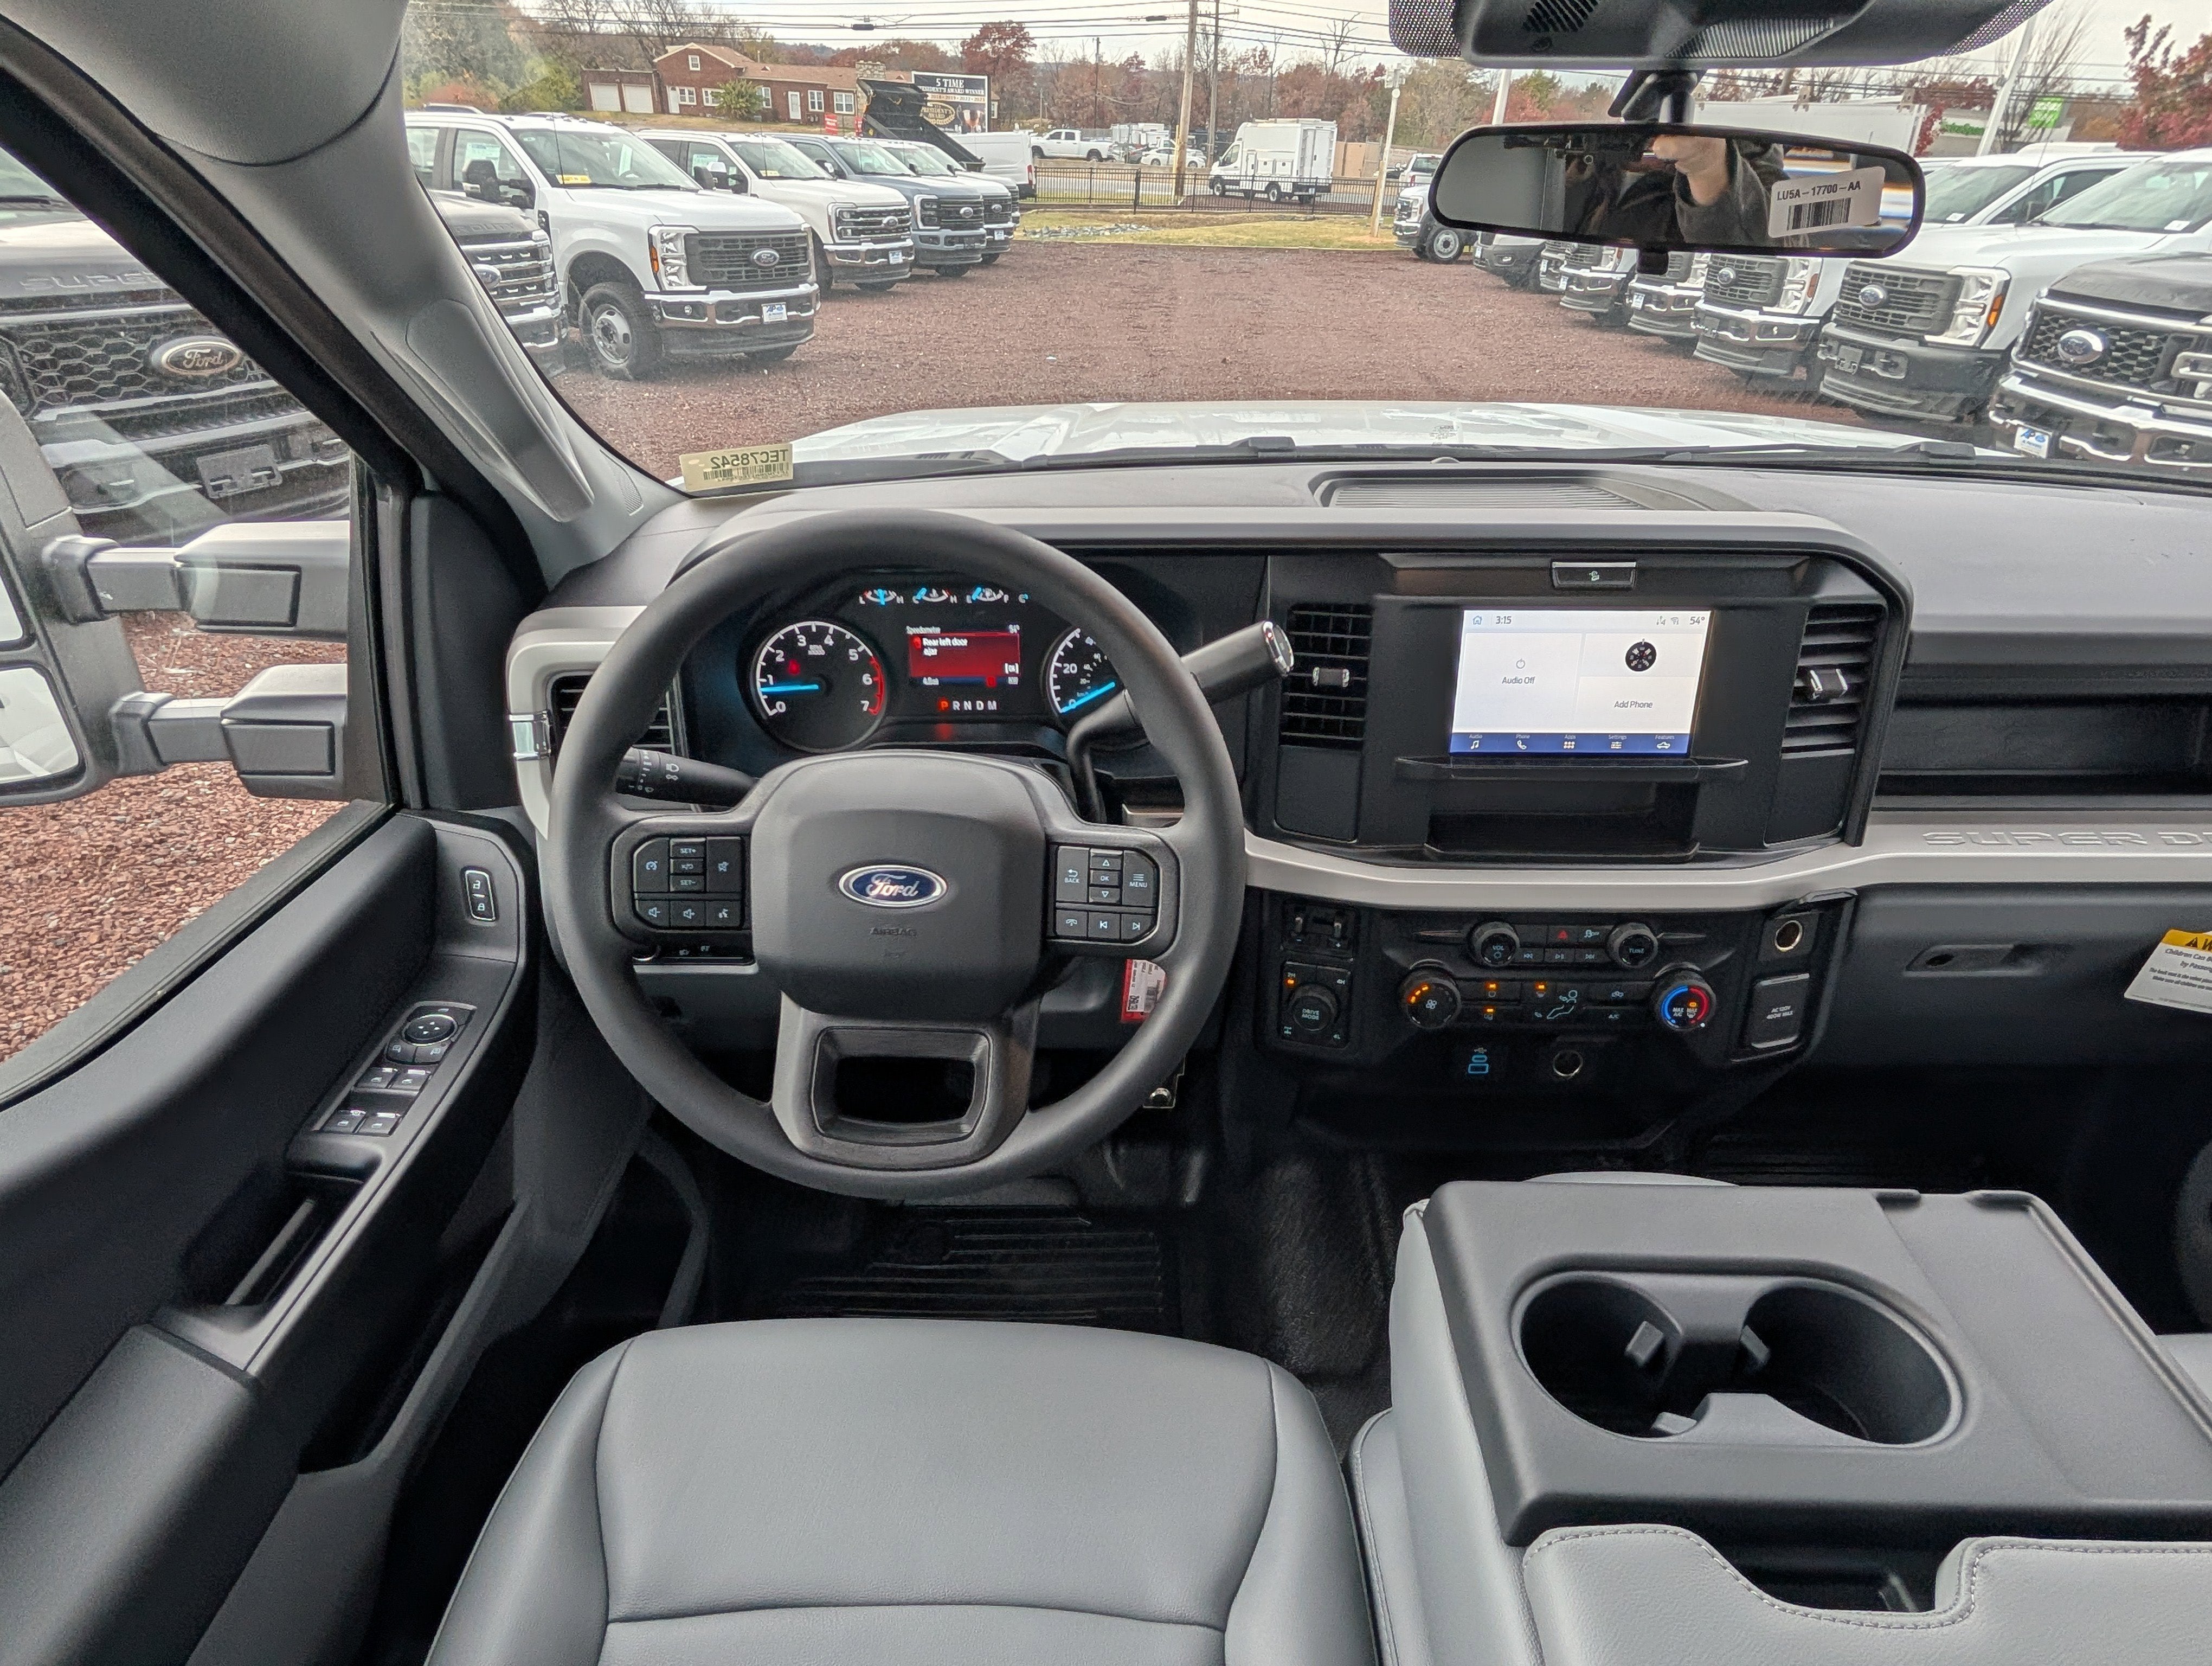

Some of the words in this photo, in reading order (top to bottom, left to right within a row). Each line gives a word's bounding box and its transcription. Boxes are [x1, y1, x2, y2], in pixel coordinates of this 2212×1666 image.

[936, 78, 941, 87] 5
[942, 79, 964, 88] TIME
[184, 348, 225, 369] Ford
[1495, 616, 1512, 625] 3:15
[1689, 616, 1706, 625] 54°
[797, 635, 807, 646] 3
[824, 635, 834, 646] 4
[923, 638, 938, 646] Rear
[951, 637, 968, 646] door
[775, 650, 785, 662] 2
[848, 649, 858, 661] 5
[1063, 663, 1078, 674] 20
[767, 675, 774, 685] 1
[862, 674, 872, 685] 6
[1501, 676, 1523, 684] Audio
[1523, 676, 1535, 684] Off
[776, 701, 786, 713] 0
[860, 700, 870, 712] 7
[941, 701, 949, 710] P
[952, 701, 961, 710] R
[963, 701, 972, 710] N
[976, 701, 984, 710] D
[987, 701, 997, 710] M
[1613, 701, 1629, 709] Add
[1629, 700, 1653, 709] Phone
[1922, 831, 2149, 845] SUPER
[865, 873, 920, 898] Ford
